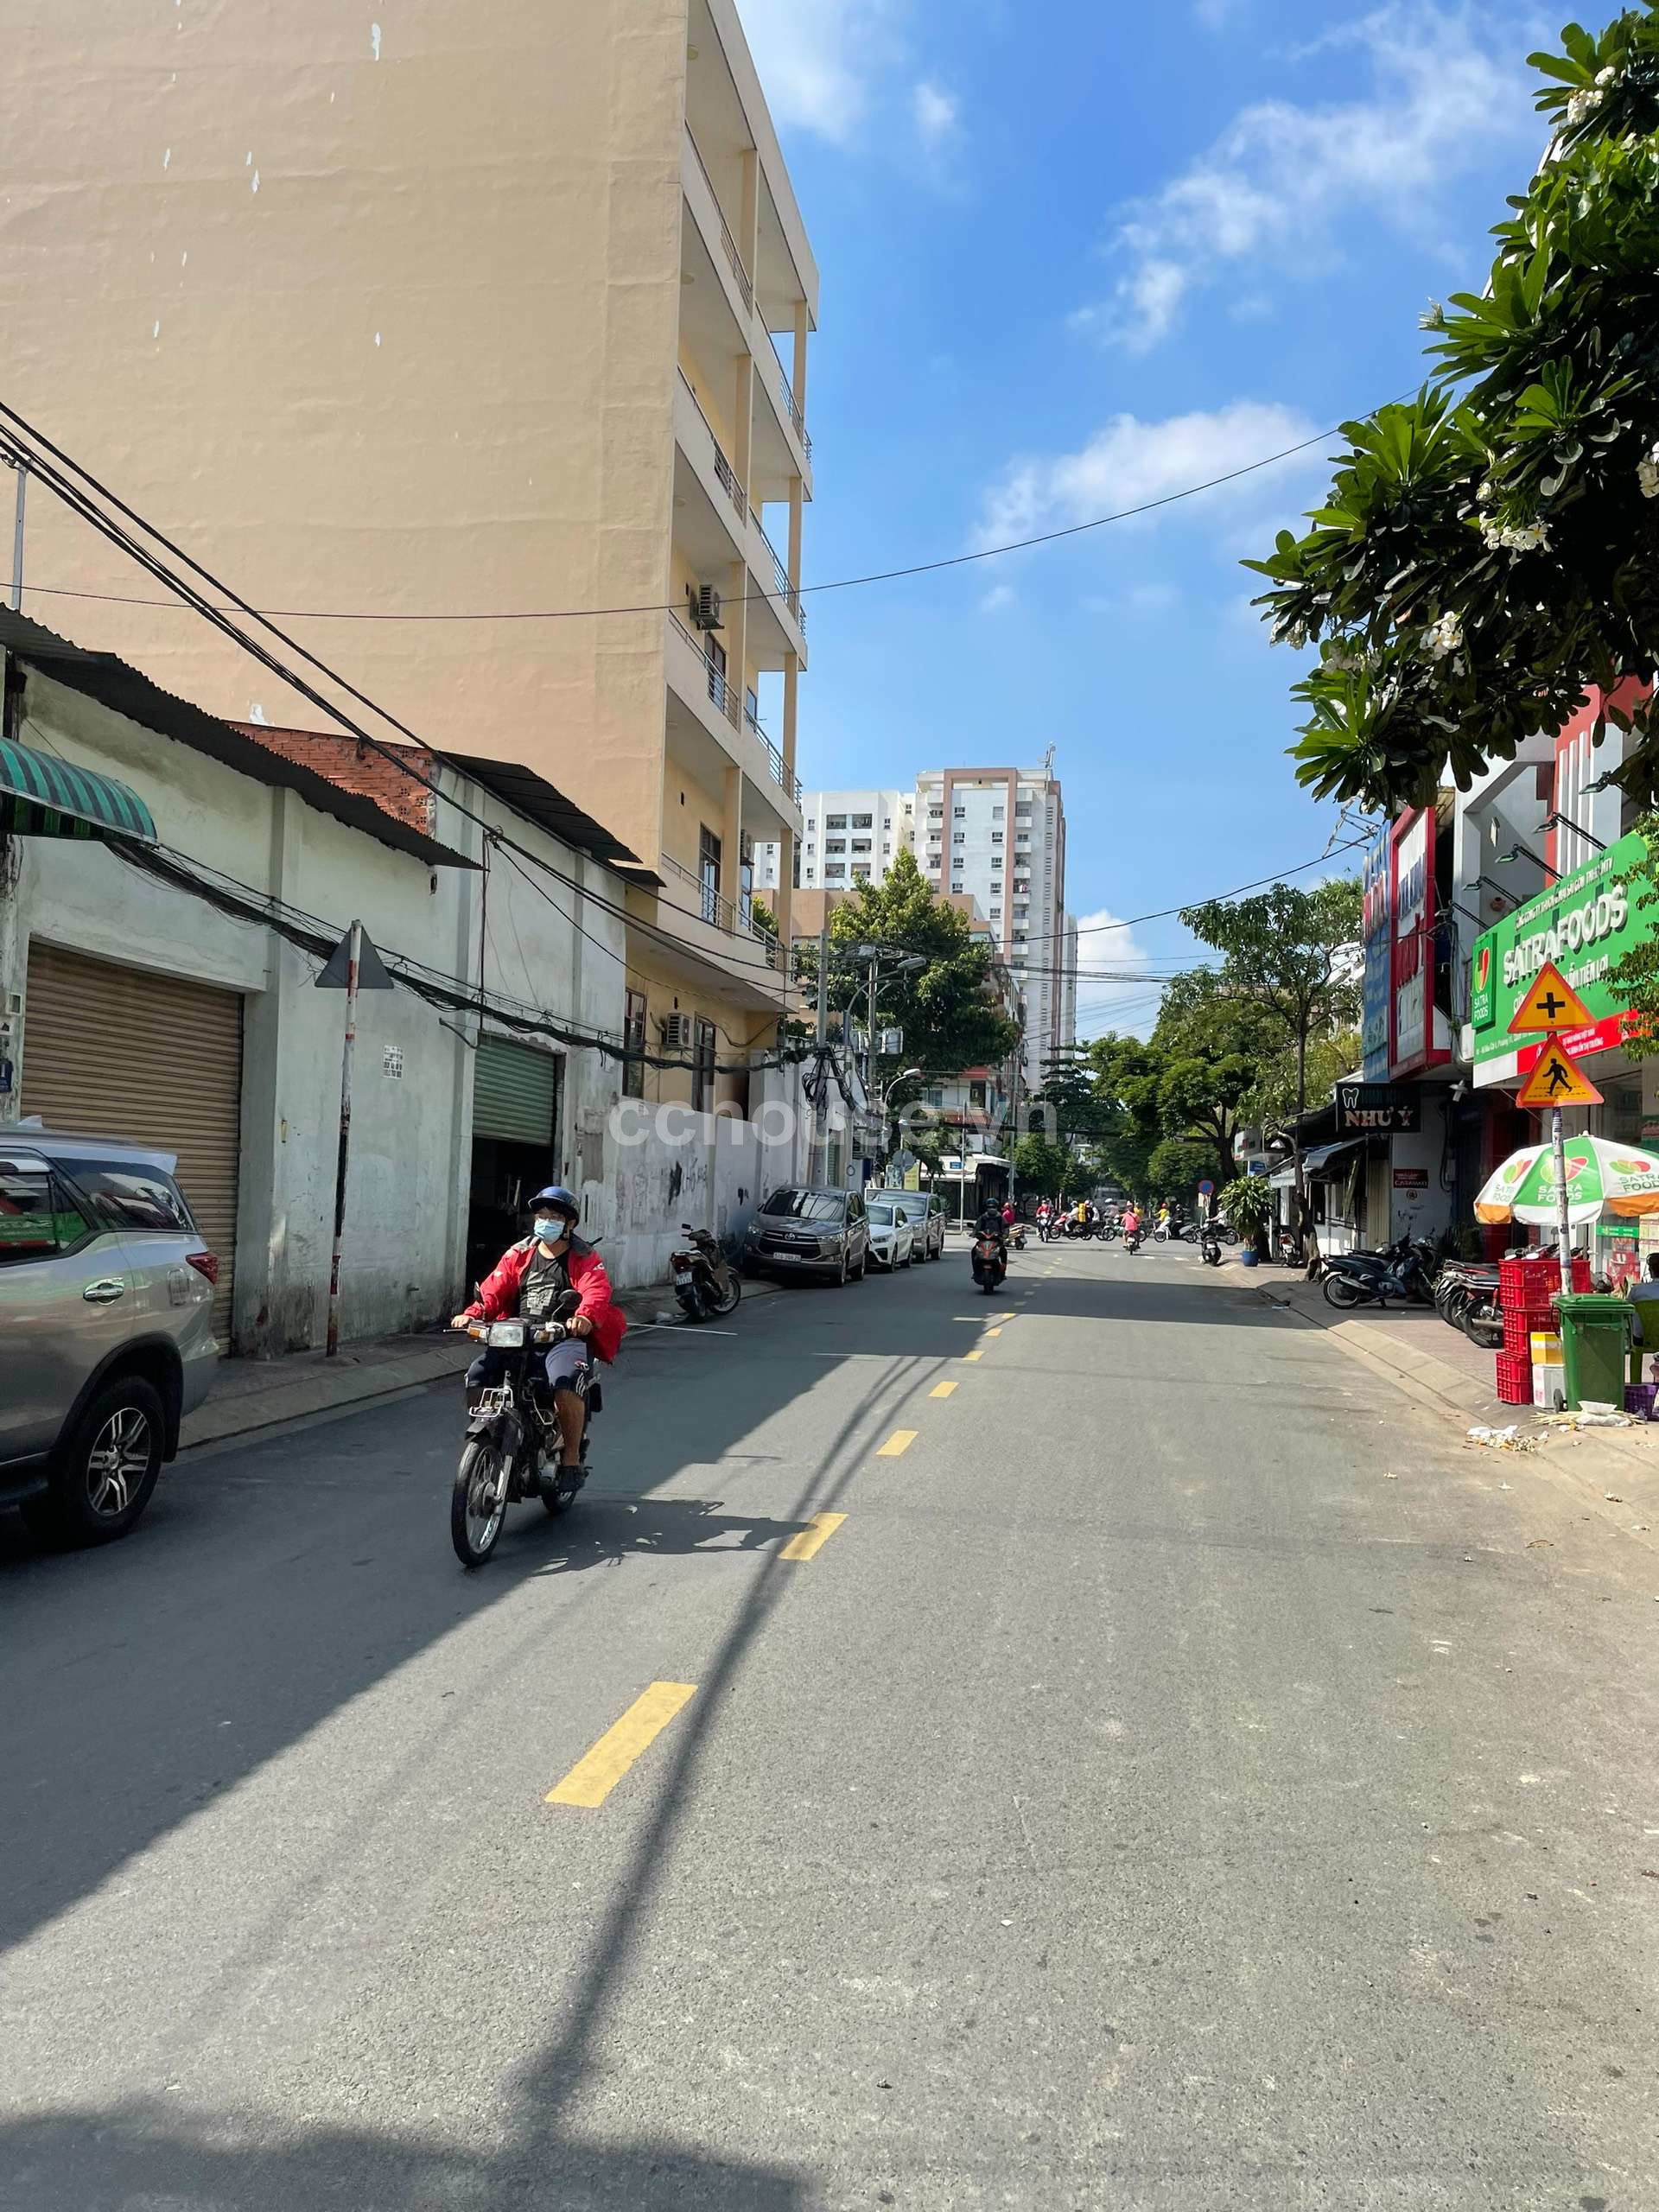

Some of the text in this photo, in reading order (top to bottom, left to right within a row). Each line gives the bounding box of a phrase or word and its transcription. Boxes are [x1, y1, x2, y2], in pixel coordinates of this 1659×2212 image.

[1503, 884, 1628, 984] SATRAFOODS
[1474, 993, 1488, 1009] SATRA
[1474, 1005, 1489, 1022] FOODS
[1344, 1106, 1394, 1127] NHƯ
[1618, 1173, 1659, 1185] SATR
[1538, 1183, 1584, 1194] SARA
[1538, 1192, 1583, 1203] FODS
